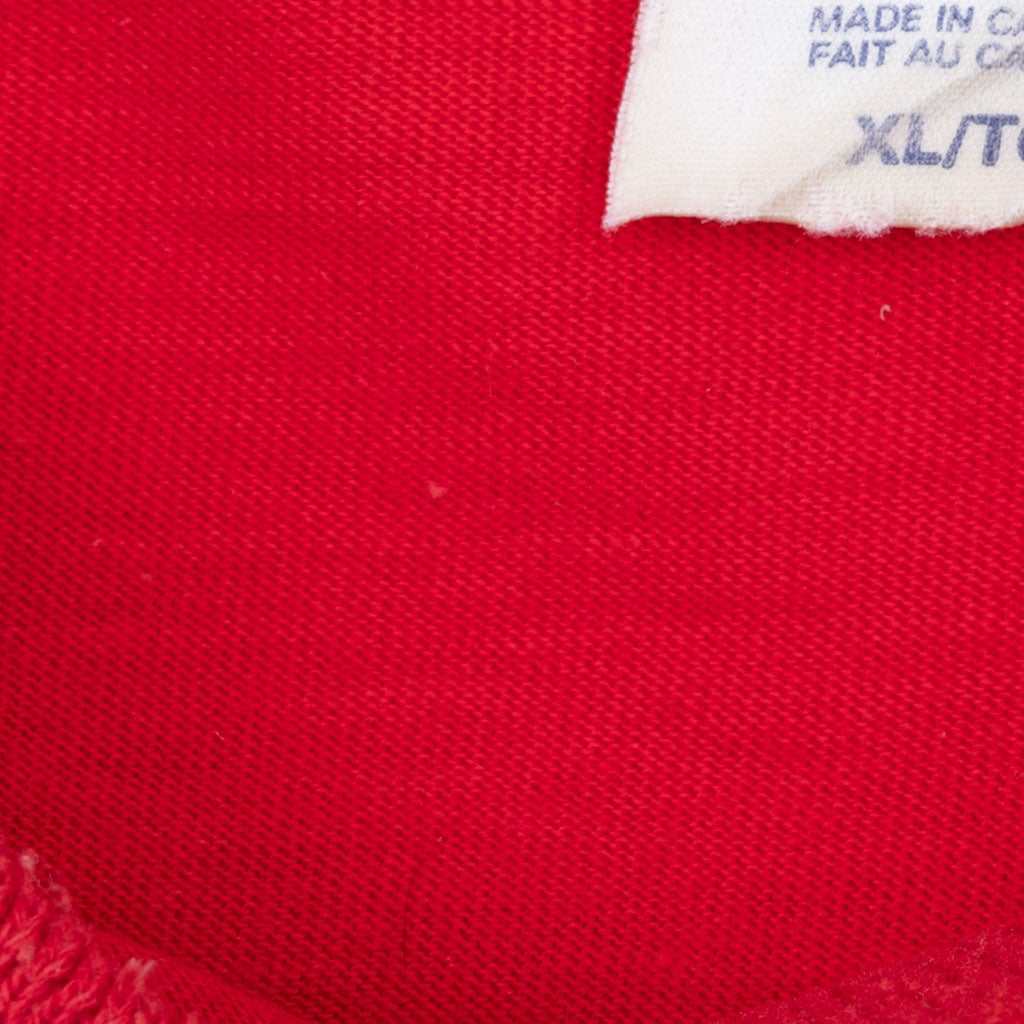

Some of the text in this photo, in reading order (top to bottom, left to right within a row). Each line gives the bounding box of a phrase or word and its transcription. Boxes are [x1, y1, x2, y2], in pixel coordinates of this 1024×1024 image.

[808, 2, 922, 34] MADE
[934, 3, 975, 33] IN
[807, 37, 896, 69] FAIT
[904, 38, 961, 69] AU
